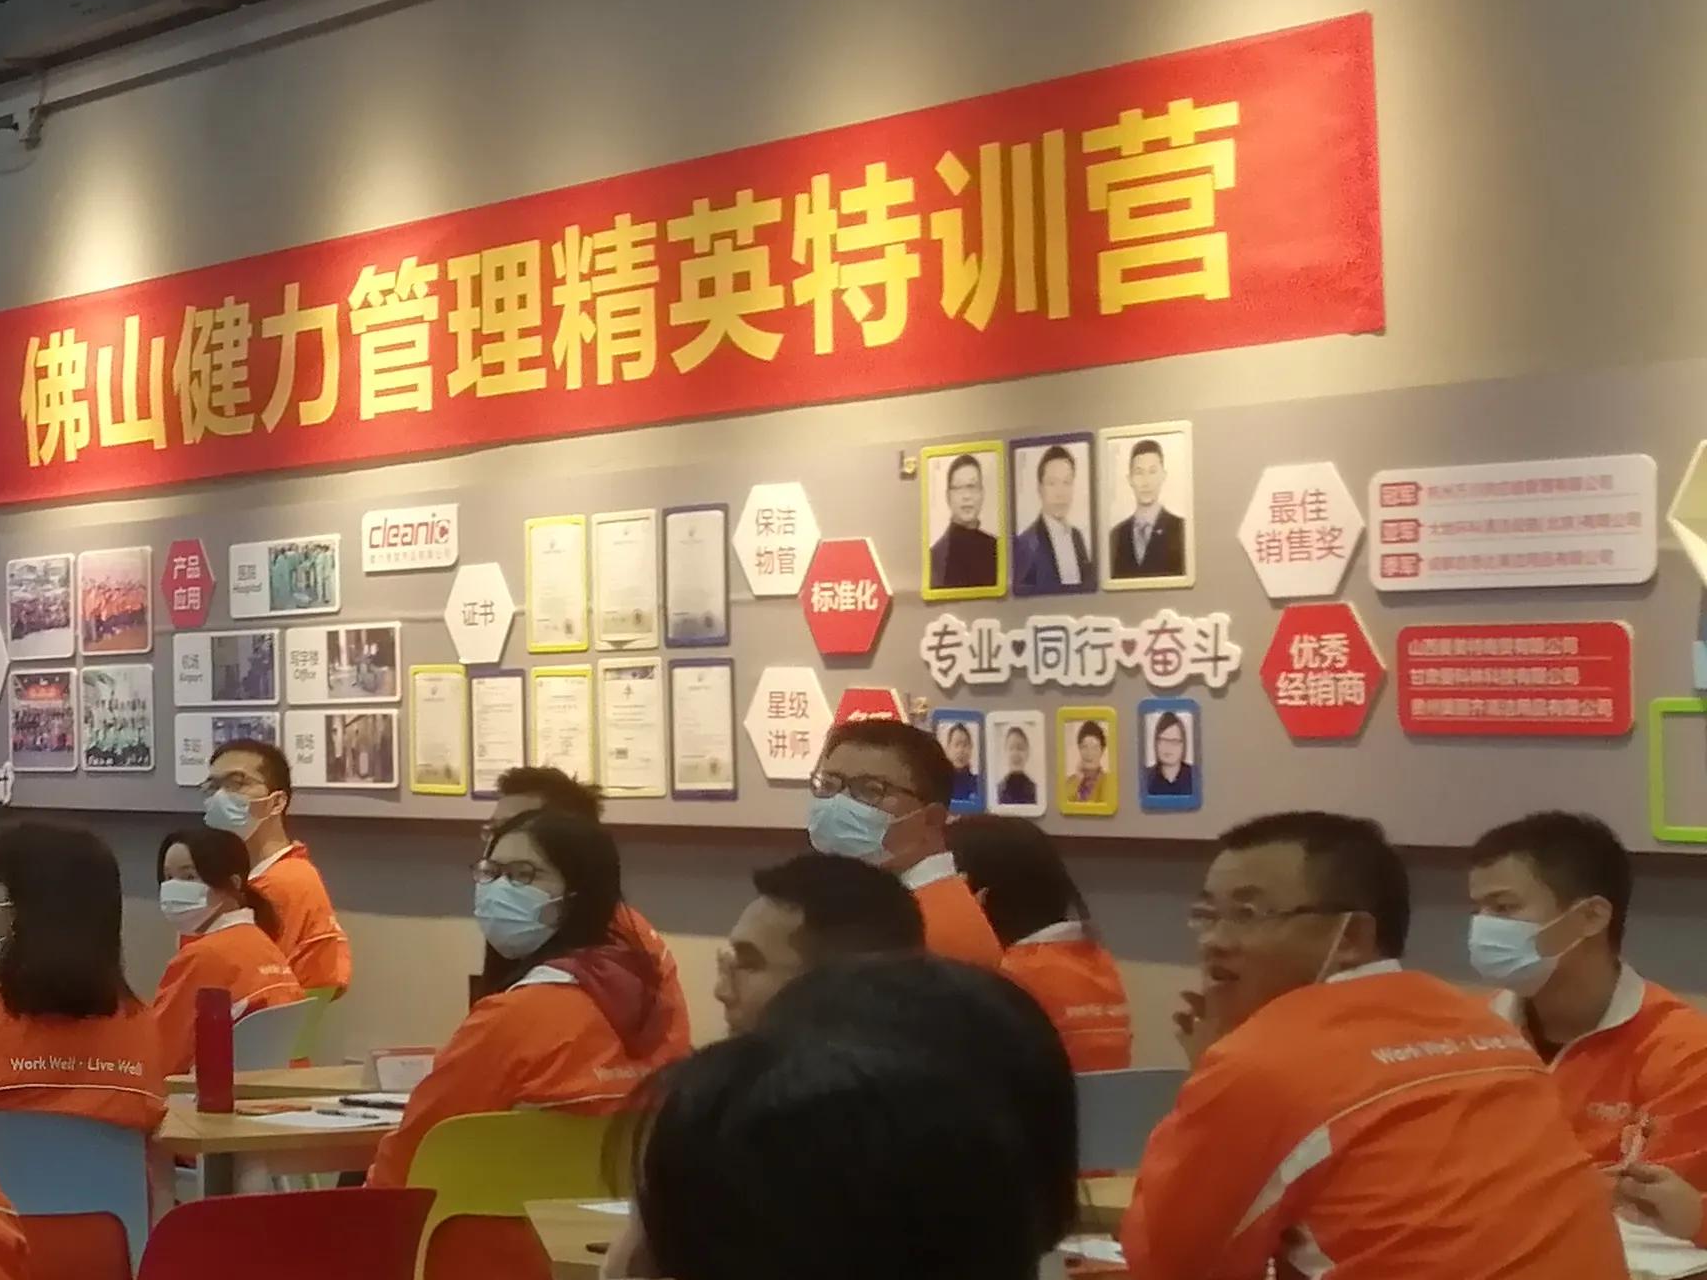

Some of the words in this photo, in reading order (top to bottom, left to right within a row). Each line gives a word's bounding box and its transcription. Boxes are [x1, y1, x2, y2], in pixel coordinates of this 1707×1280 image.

[18, 97, 1240, 469] 佛山健力管理精英特训营
[754, 507, 797, 538] 保洁
[1269, 488, 1330, 526] 最佳
[368, 513, 451, 549] cleanic
[1254, 526, 1347, 565] 销售奖
[172, 554, 201, 580] 产品
[754, 546, 797, 577] 物管
[810, 578, 879, 613] 标准化
[461, 600, 495, 627] 证书
[927, 622, 1002, 679] 专业
[1033, 623, 1116, 678] 同行
[1146, 621, 1232, 679] 奋斗
[1289, 632, 1349, 670] 优秀
[766, 690, 810, 720] 星级
[1275, 671, 1366, 709] 经销商
[766, 728, 811, 762] 讲师
[10, 1056, 46, 1071] Work
[87, 1056, 116, 1072] Live
